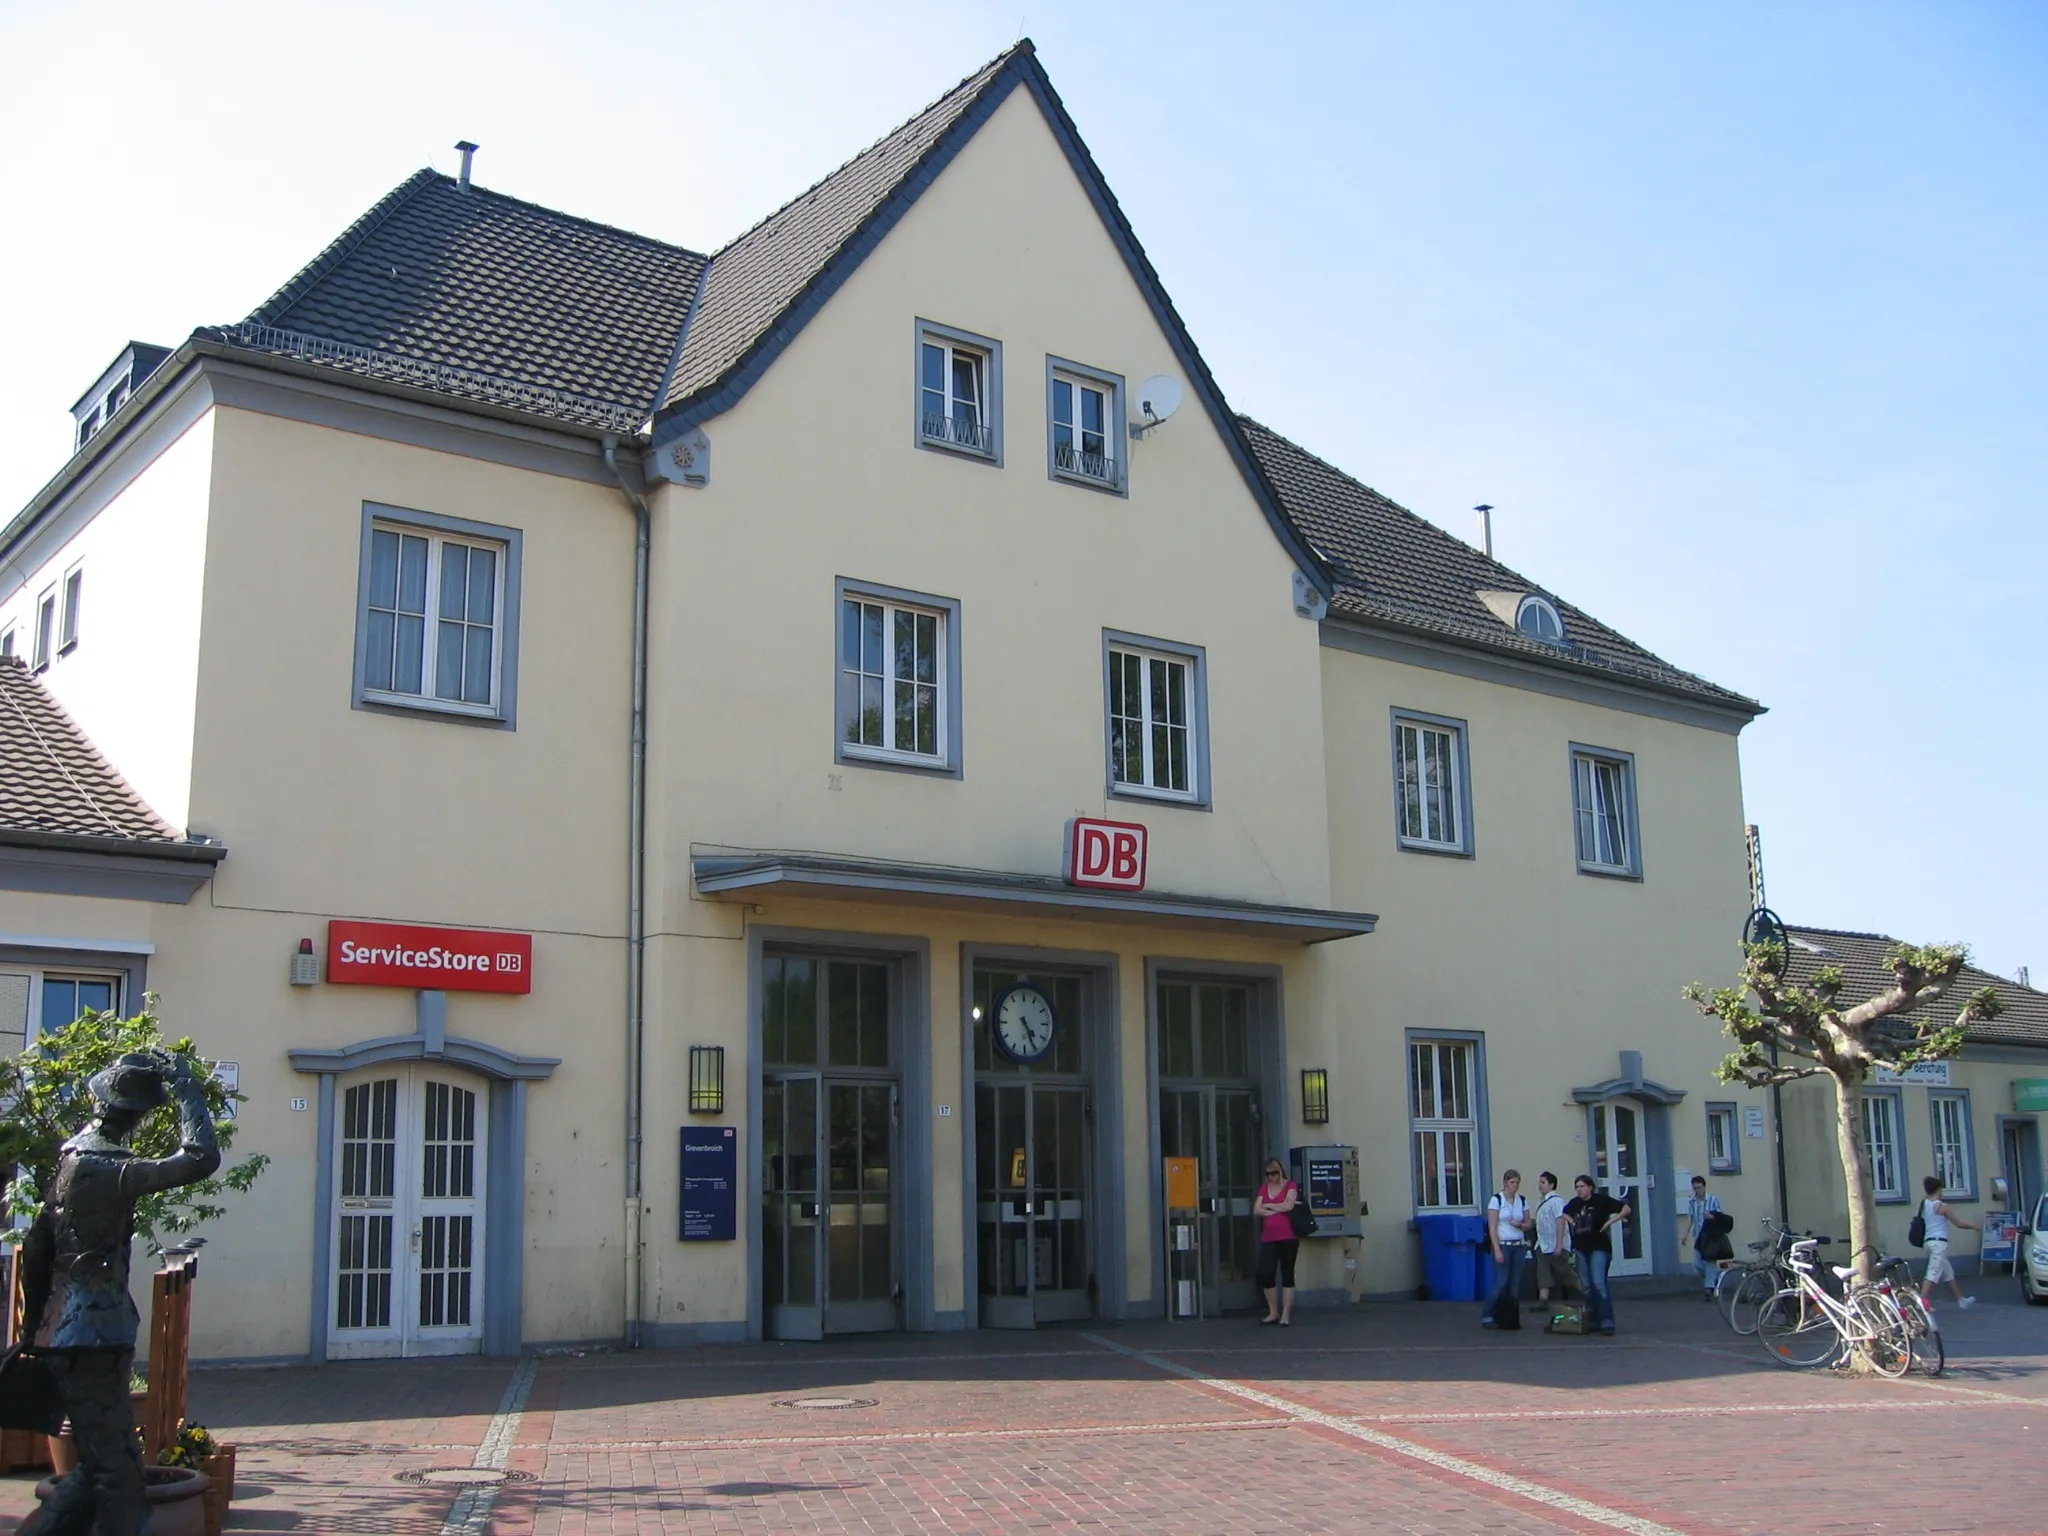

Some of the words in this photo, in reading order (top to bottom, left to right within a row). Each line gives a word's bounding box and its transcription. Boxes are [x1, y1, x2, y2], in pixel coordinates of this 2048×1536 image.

[1082, 829, 1138, 879] DB
[341, 941, 490, 972] ServiceStore
[499, 954, 520, 971] DB
[292, 1099, 305, 1109] 15
[940, 1106, 950, 1115] 17
[685, 1144, 723, 1152] Grevenbroich
